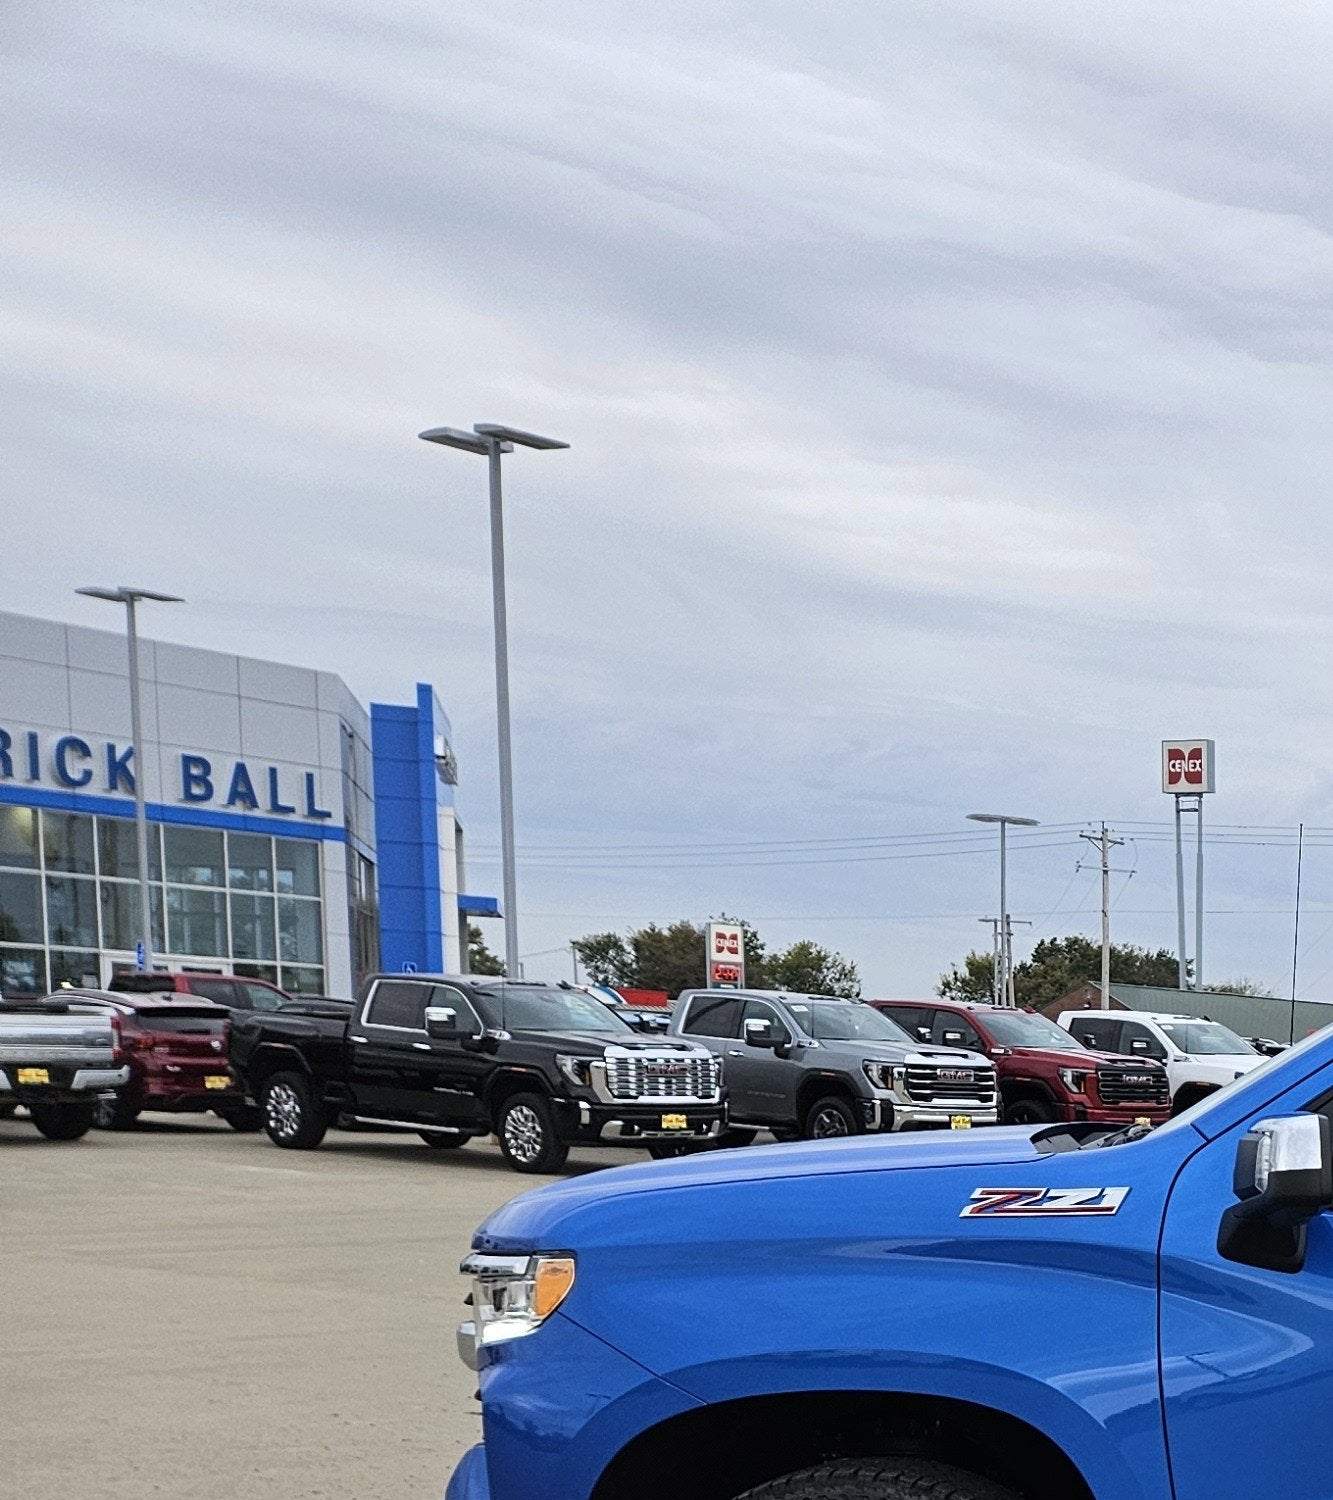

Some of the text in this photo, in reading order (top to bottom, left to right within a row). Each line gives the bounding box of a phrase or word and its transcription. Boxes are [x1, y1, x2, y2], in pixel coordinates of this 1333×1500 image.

[1169, 759, 1202, 773] CENEX
[181, 753, 332, 819] BALL
[958, 1186, 1132, 1218] Z71
